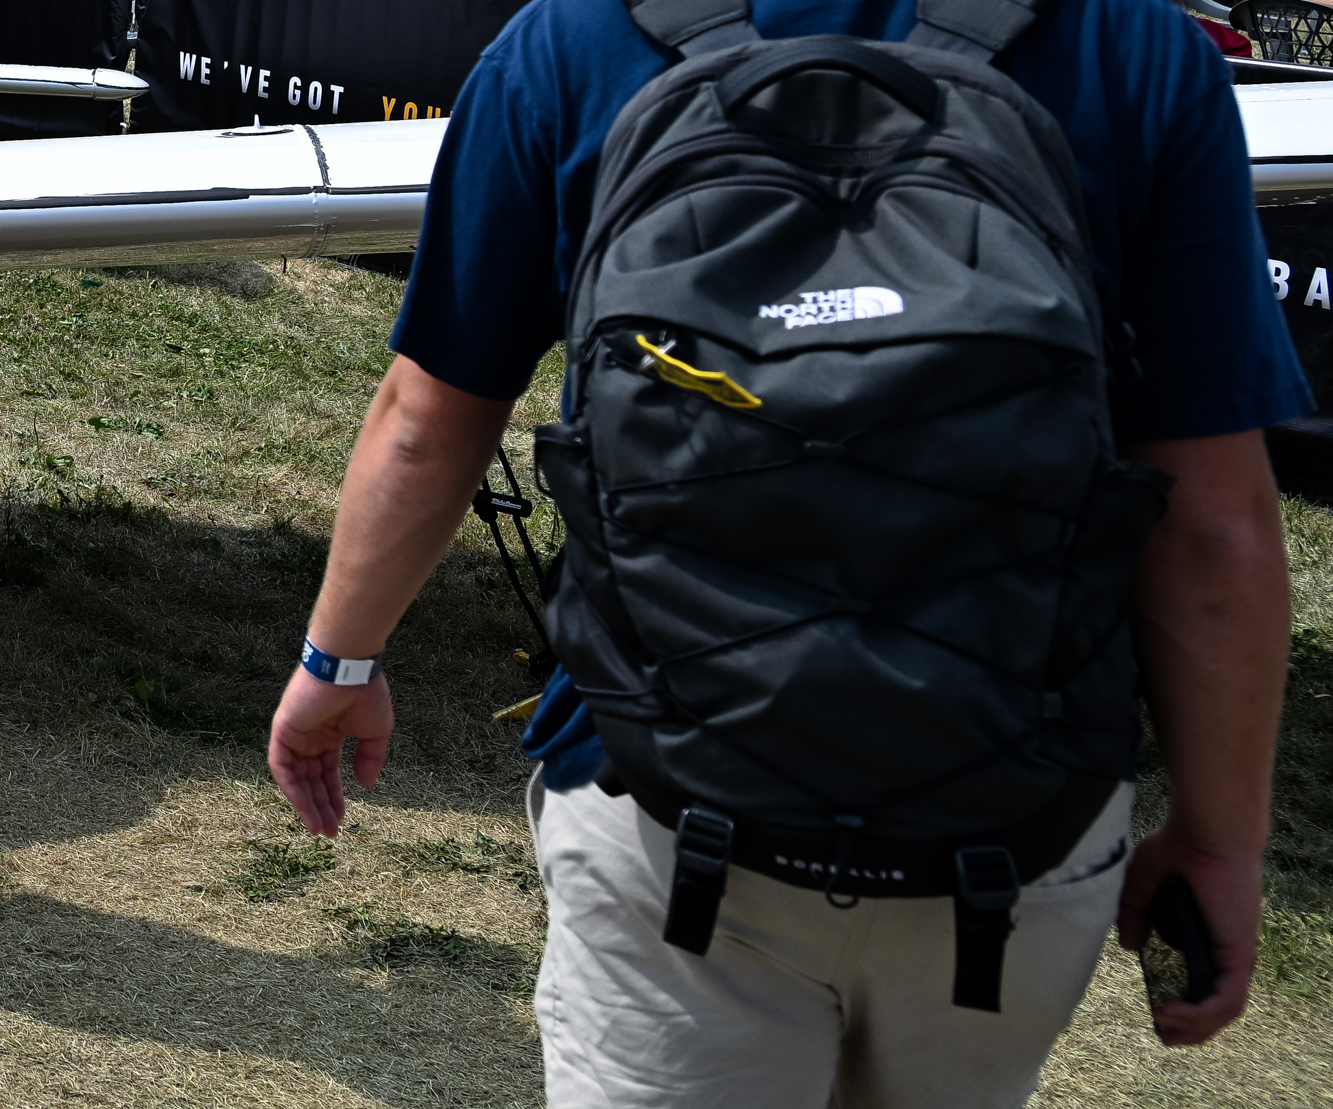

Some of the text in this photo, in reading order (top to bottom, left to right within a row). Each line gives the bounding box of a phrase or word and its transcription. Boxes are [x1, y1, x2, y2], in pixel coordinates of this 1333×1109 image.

[179, 50, 271, 99] WE'VE
[287, 76, 345, 116] GOT
[798, 288, 854, 305] THE
[758, 303, 854, 319] NORTH
[784, 311, 854, 330] FACE
